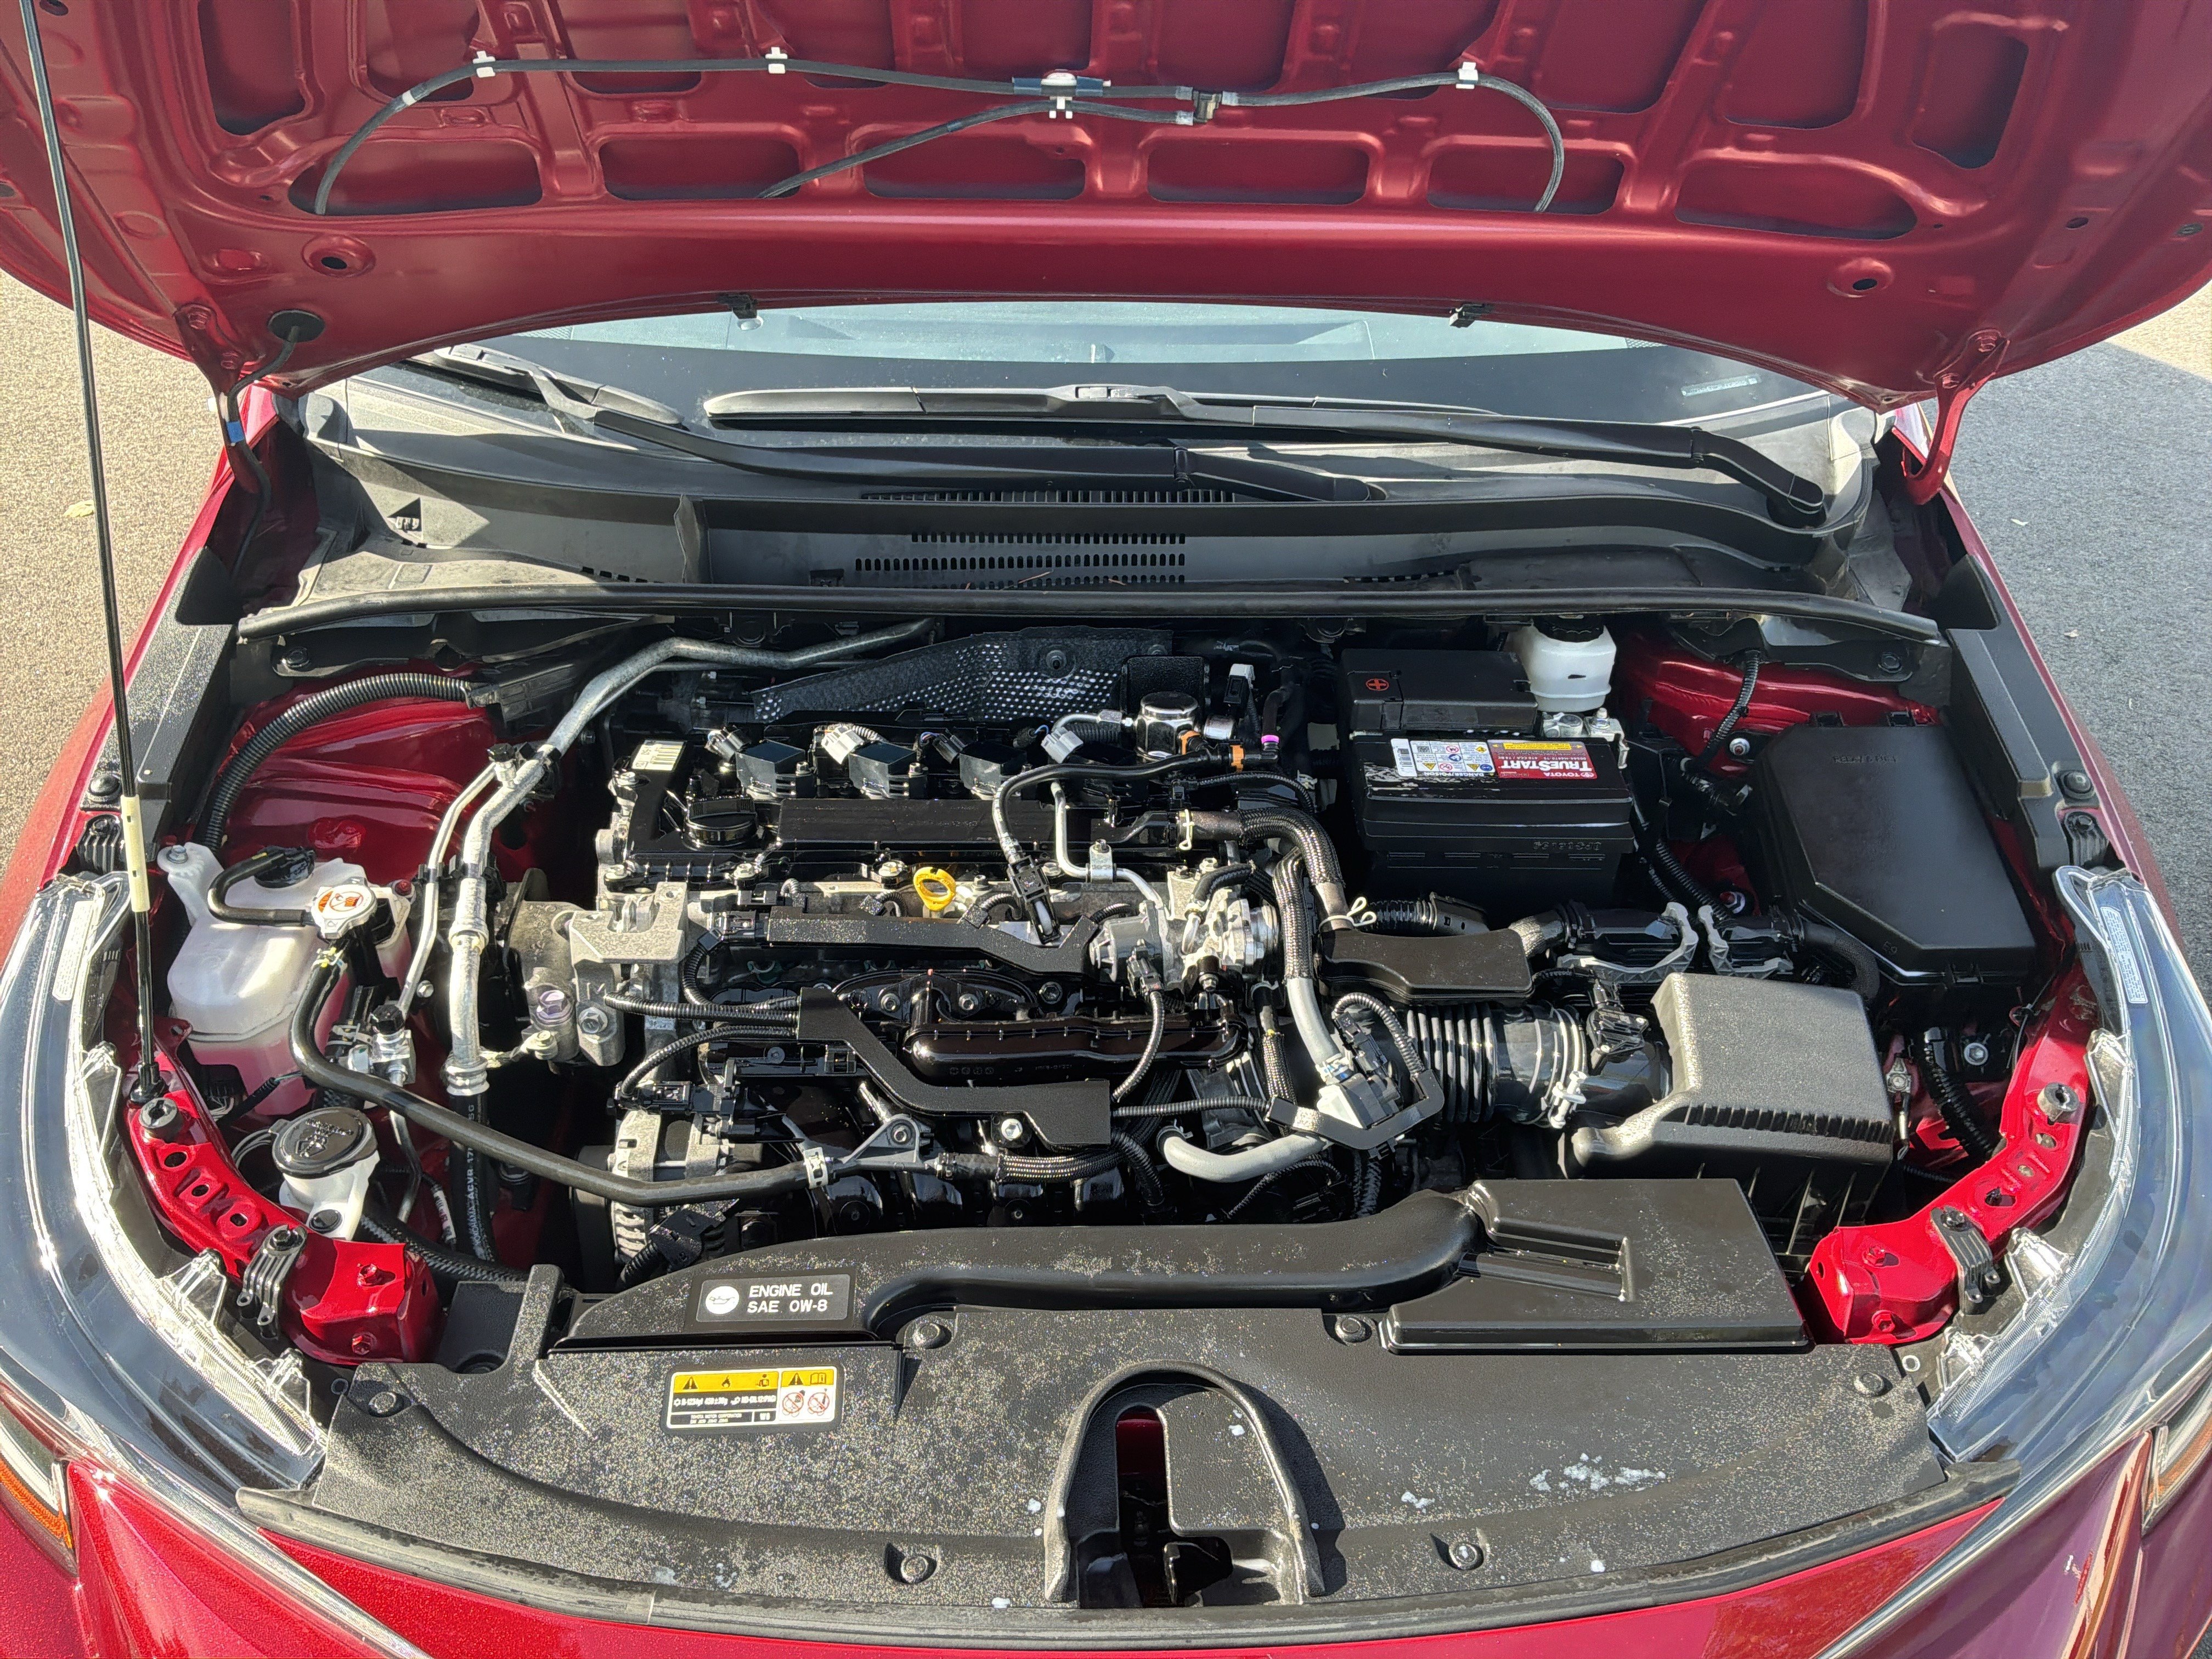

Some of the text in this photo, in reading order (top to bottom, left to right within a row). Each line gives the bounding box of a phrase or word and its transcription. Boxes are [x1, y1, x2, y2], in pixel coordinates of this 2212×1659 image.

[468, 1205, 481, 1246] YOKOHAMA
[749, 1283, 833, 1298] ENGINE OIL
[747, 1299, 828, 1313] SAE 0W-8
